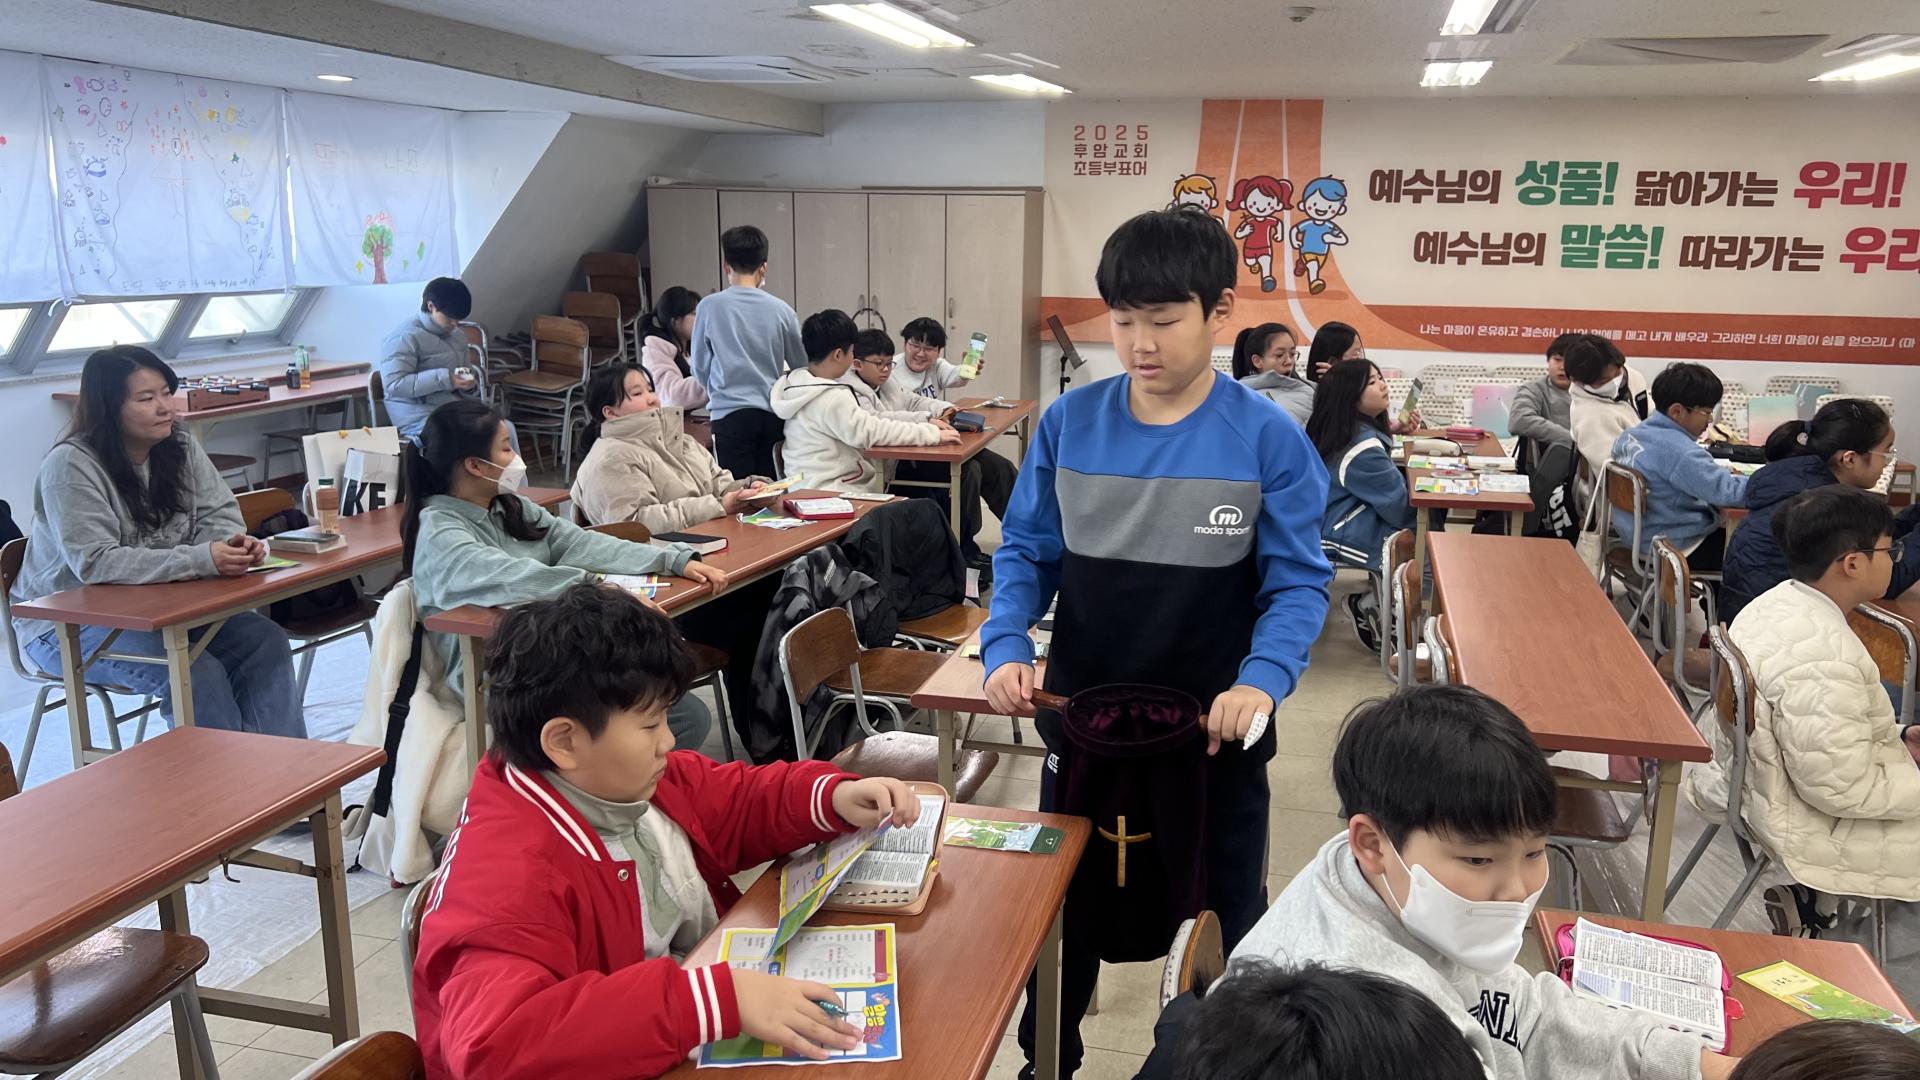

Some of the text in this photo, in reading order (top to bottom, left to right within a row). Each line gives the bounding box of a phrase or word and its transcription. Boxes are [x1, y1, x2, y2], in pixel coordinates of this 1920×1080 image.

[1074, 124, 1149, 140] 2025
[1074, 143, 1148, 158] 후암교회
[1073, 161, 1148, 176] 초등부표어
[1368, 160, 1908, 208] 예수님의 성품! 닮아가는 우리!
[1413, 231, 1547, 266] 예수님의
[1560, 224, 1665, 269] 말씀!
[1678, 235, 1825, 272] 따라가는
[1420, 324, 1441, 335] 나는
[1443, 324, 1475, 336] 마음이
[1477, 326, 1519, 337] 온유하고
[1625, 330, 1648, 341] 메고
[1650, 330, 1672, 342] 내게
[1674, 331, 1709, 343] 배우라
[1711, 332, 1757, 344] 그리하면
[1759, 333, 1783, 345] 너희
[1784, 334, 1820, 346] 마음이
[1822, 335, 1846, 347] 쉼을
[1848, 335, 1896, 348] 얻으리니
[1193, 525, 1224, 536] moda
